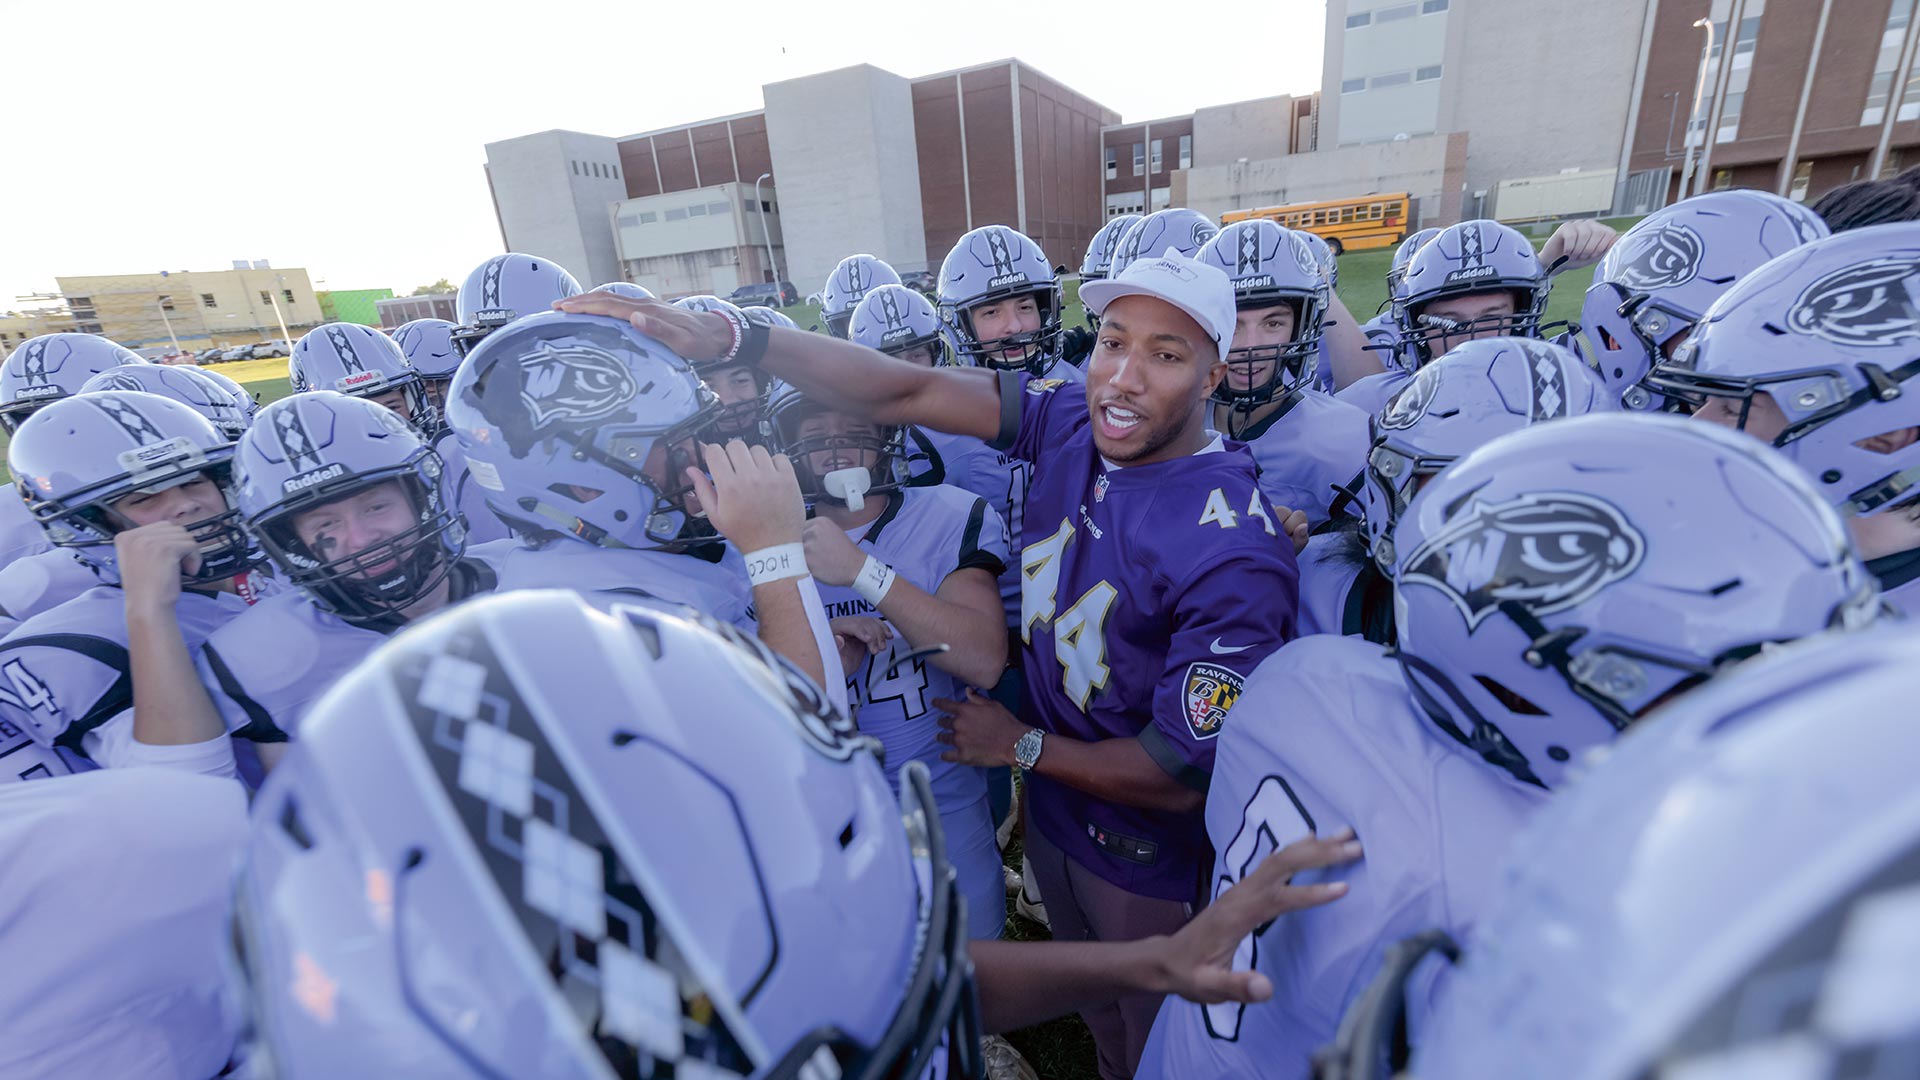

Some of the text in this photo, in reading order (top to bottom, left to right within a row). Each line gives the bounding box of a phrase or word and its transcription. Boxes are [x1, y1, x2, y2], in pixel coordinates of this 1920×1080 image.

[990, 272, 1026, 288] Riddell
[478, 310, 506, 321] Riddell
[883, 327, 913, 342] Riddell
[345, 371, 373, 385] Riddell
[15, 385, 58, 399] Riddell
[282, 462, 344, 494] Riddell
[1198, 487, 1277, 537] 44
[1080, 504, 1103, 540] RVENS
[1021, 516, 1119, 714] 44
[1196, 667, 1244, 690] RAVENS
